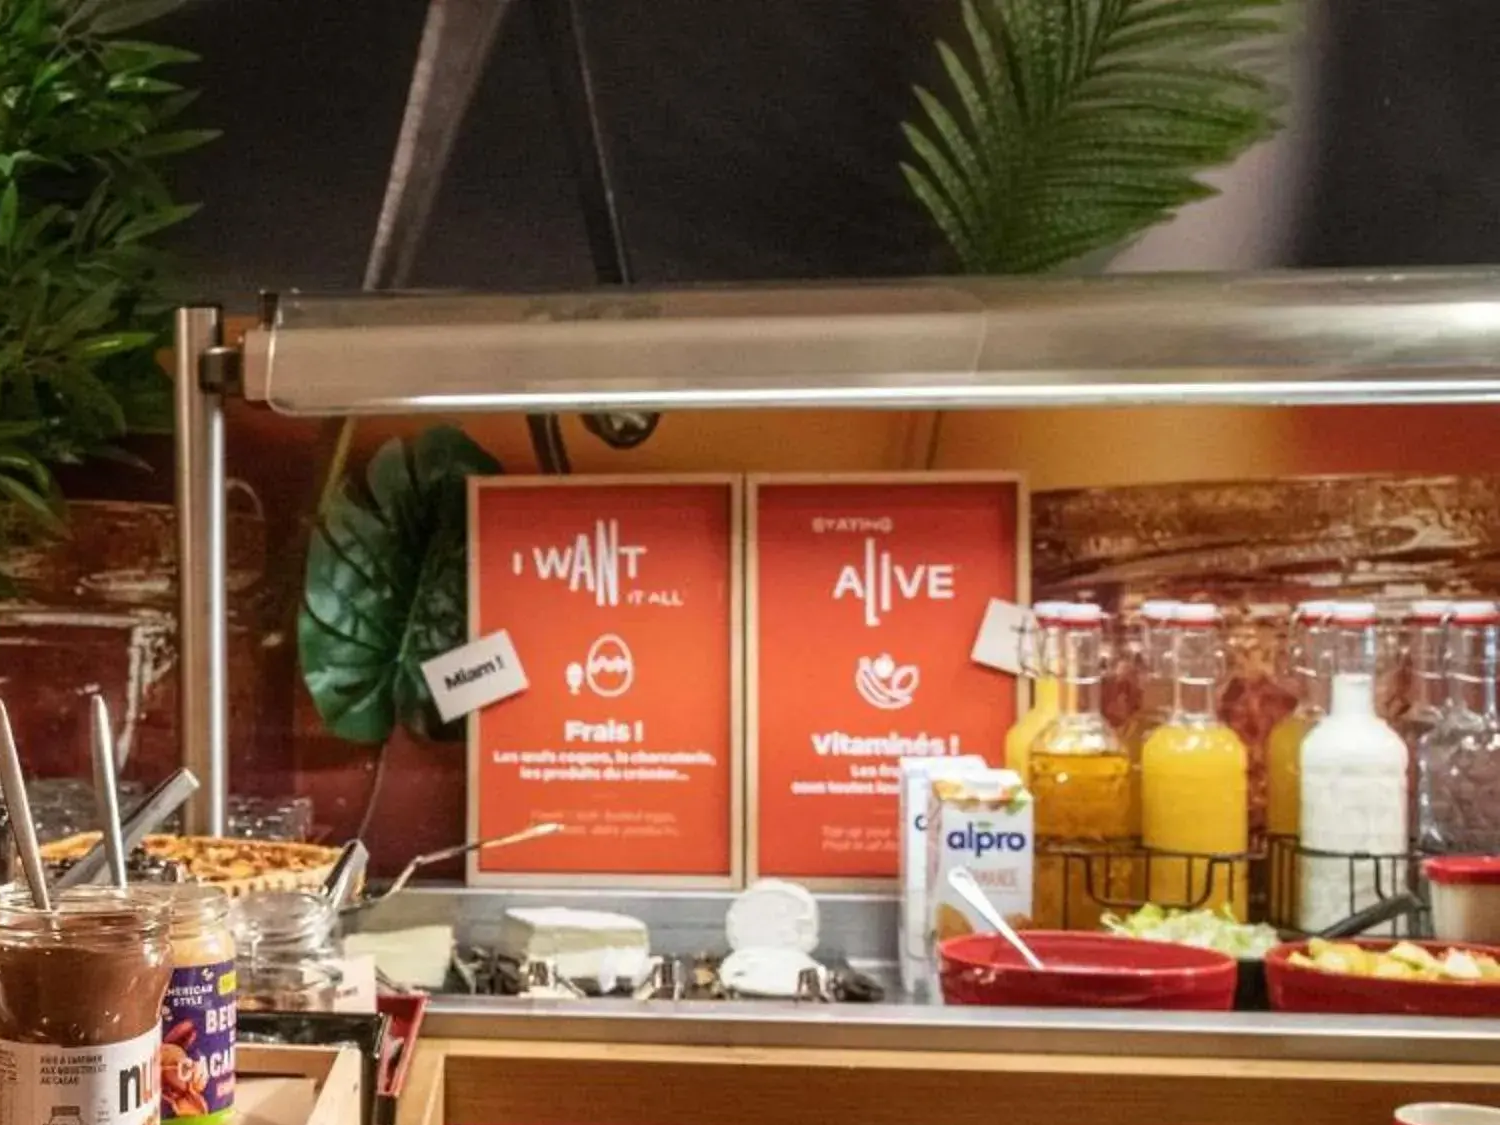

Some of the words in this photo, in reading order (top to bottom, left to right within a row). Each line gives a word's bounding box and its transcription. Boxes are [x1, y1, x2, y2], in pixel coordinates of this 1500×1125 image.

[512, 551, 523, 576] I
[532, 518, 648, 607] WANT
[648, 589, 684, 606] ALL
[832, 537, 954, 627] ALIVE
[444, 659, 497, 692] Miam
[564, 718, 631, 742] Frais
[810, 730, 946, 756] Vitaminés
[947, 822, 1026, 858] alpro
[205, 1002, 236, 1034] BEU
[120, 1058, 155, 1114] nu
